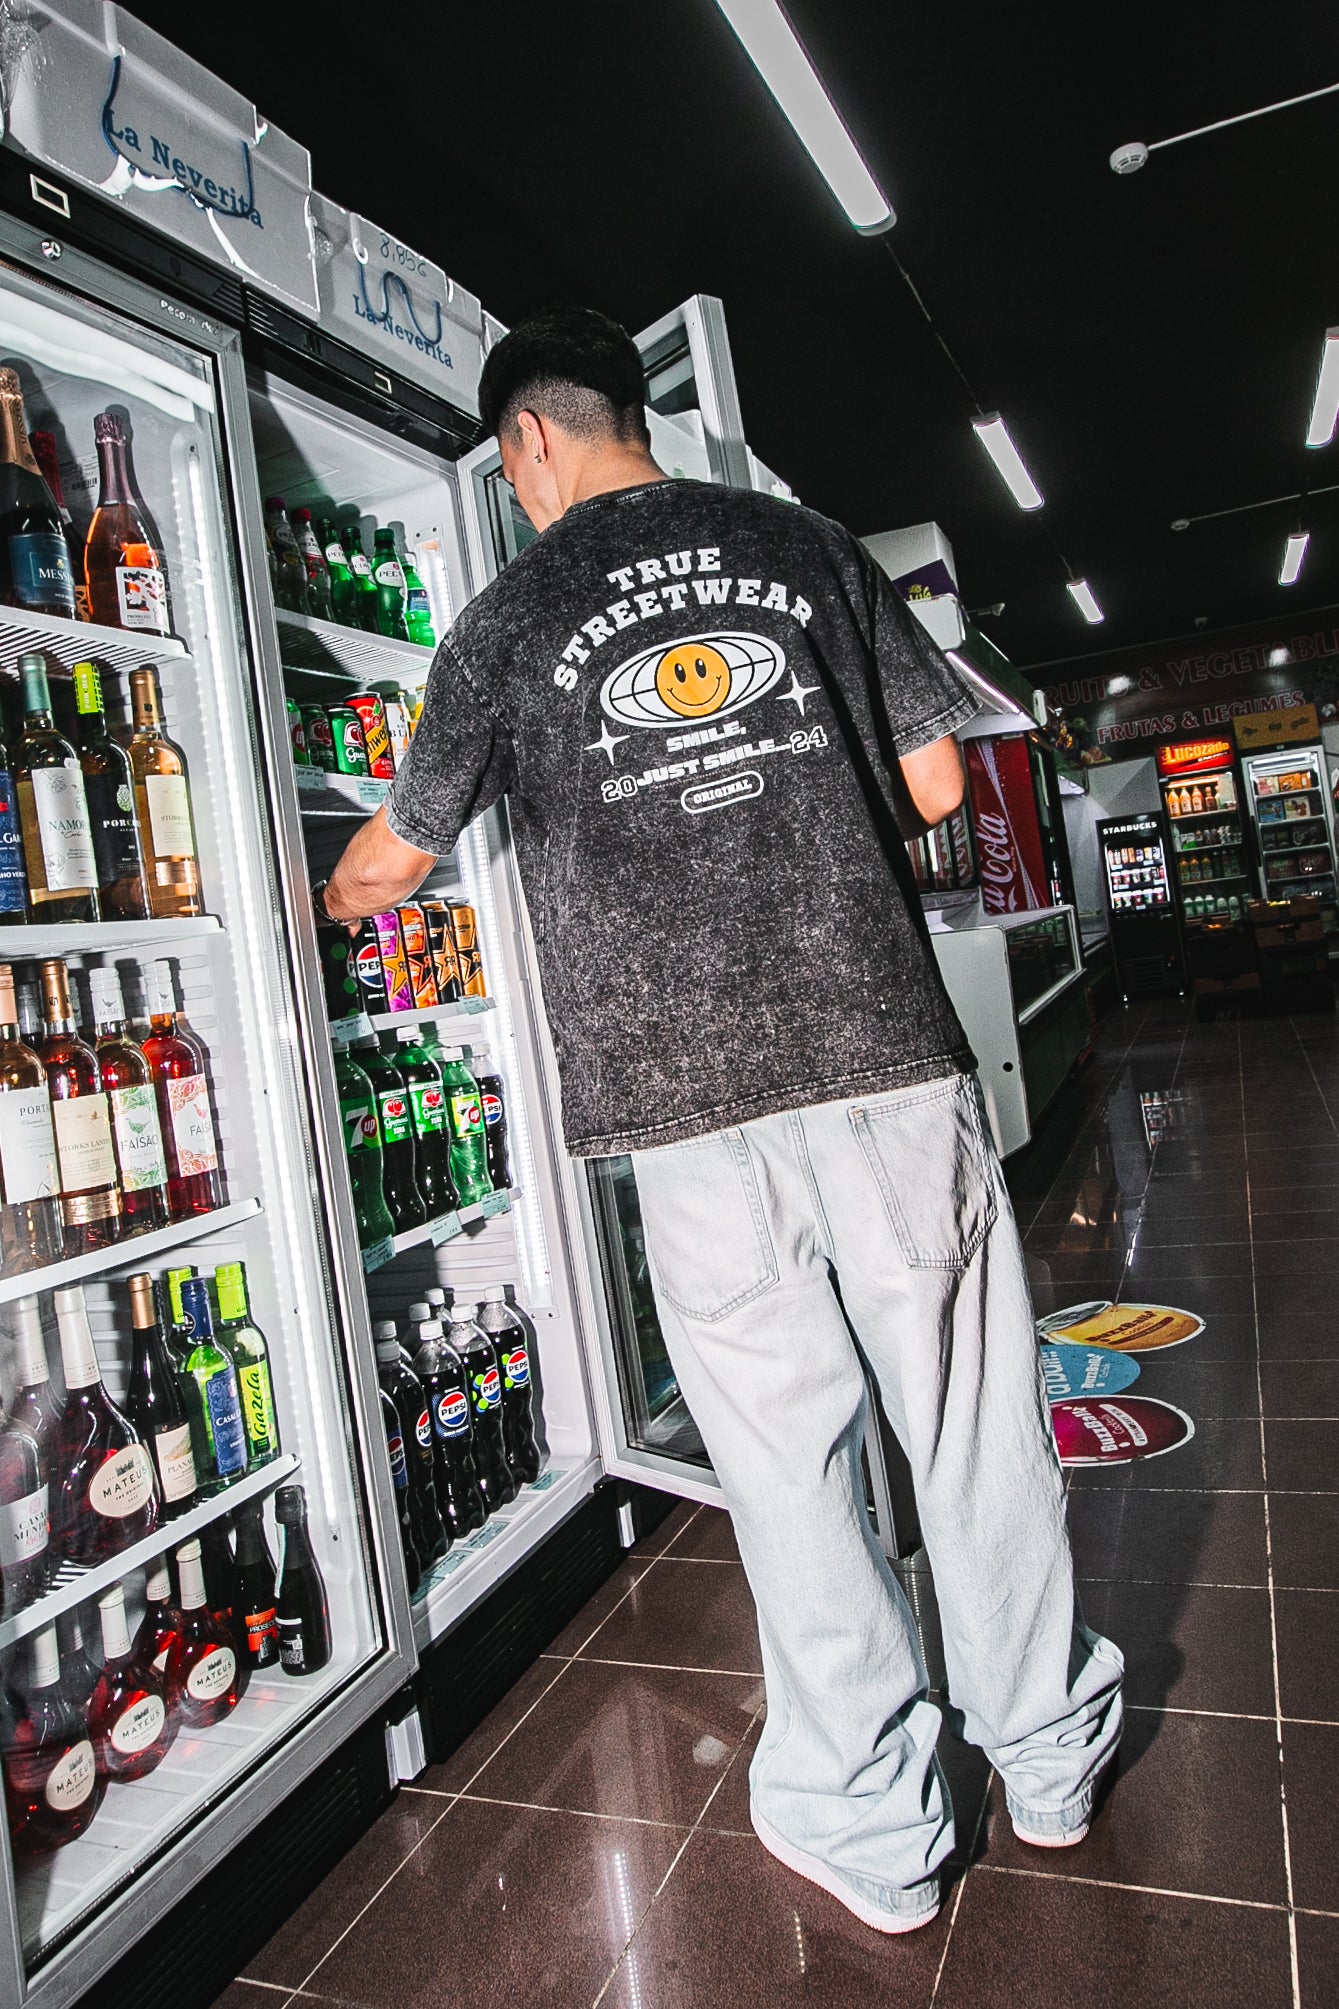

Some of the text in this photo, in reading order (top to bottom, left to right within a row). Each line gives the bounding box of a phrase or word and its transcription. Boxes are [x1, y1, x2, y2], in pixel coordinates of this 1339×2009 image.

[105, 108, 264, 230] La Neverita
[352, 294, 454, 370] La Neverita
[606, 547, 721, 592] TRUE
[553, 577, 813, 691] STREETWEAR
[1137, 665, 1164, 692] &
[1096, 690, 1307, 745] FRUTAS & LEGUMES
[1164, 741, 1231, 766] Lucozade
[636, 759, 700, 788] JUST
[692, 780, 753, 805] ORIGINAL
[1102, 821, 1158, 835] STARBUCKS
[976, 811, 1014, 884] Cola
[246, 1371, 267, 1437] Gazela
[441, 1402, 466, 1416] PEPSI
[102, 1466, 148, 1498] MATEUS
[196, 1661, 232, 1687] MATEUS
[122, 1709, 161, 1739] MATEUS
[56, 1758, 93, 1793] MATEUS
